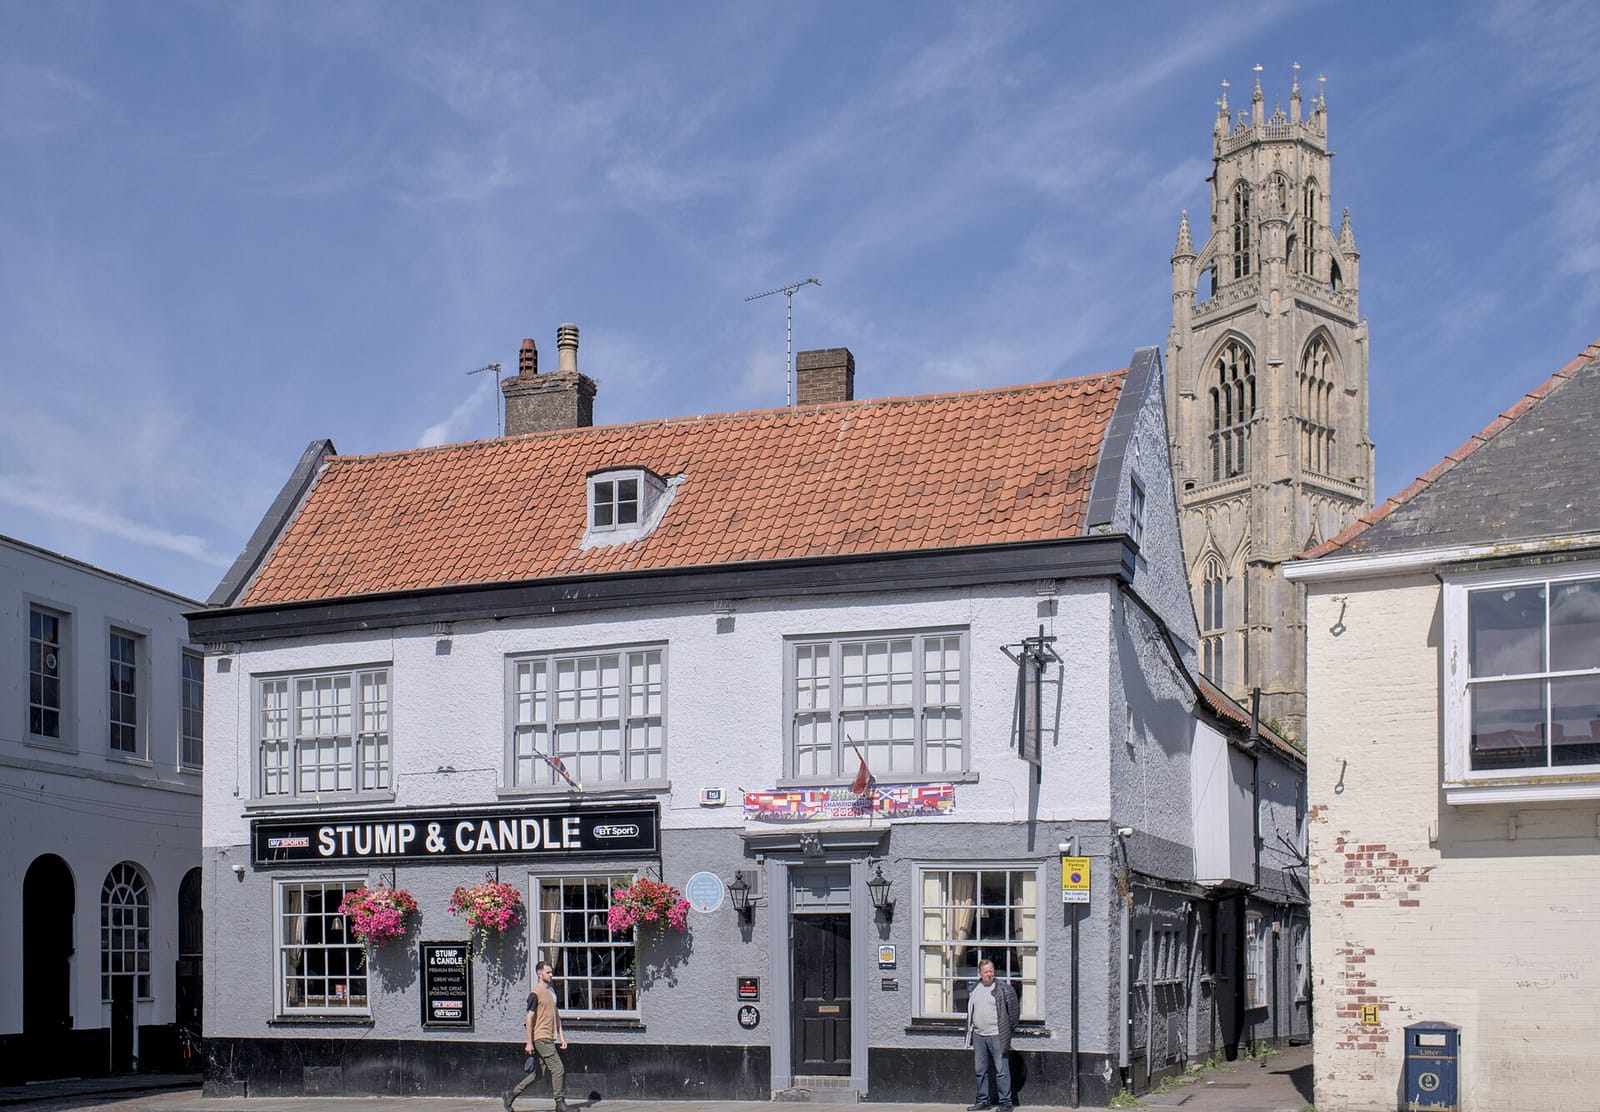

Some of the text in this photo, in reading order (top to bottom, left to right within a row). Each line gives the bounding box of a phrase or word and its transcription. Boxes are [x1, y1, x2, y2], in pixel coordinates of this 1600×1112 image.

[833, 807, 861, 817] 2024
[318, 816, 582, 856] STUMP & CANDLE
[598, 826, 634, 837] BT Sport
[282, 838, 308, 847] SPORTS
[1364, 1007, 1376, 1022] H
